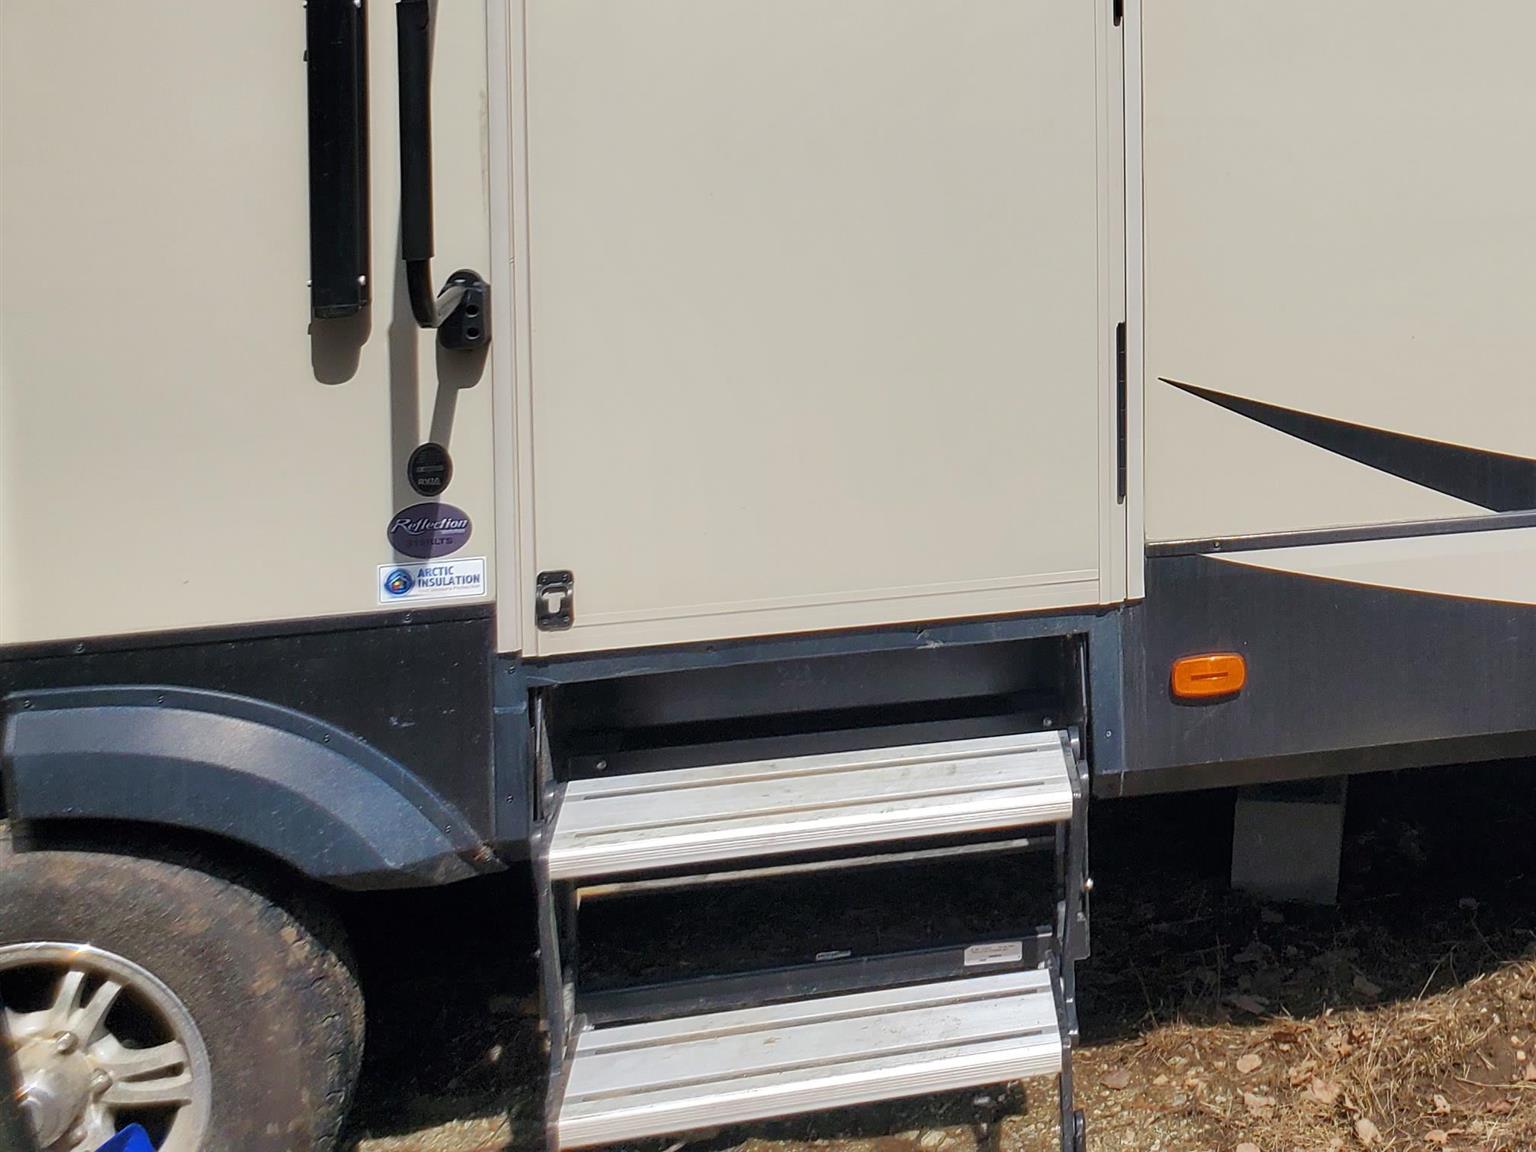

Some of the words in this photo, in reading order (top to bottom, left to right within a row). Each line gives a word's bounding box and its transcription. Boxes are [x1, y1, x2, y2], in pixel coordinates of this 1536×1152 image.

[391, 518, 469, 535] Reflection
[417, 566, 454, 578] ARCTIC
[417, 574, 481, 588] INSULATION
